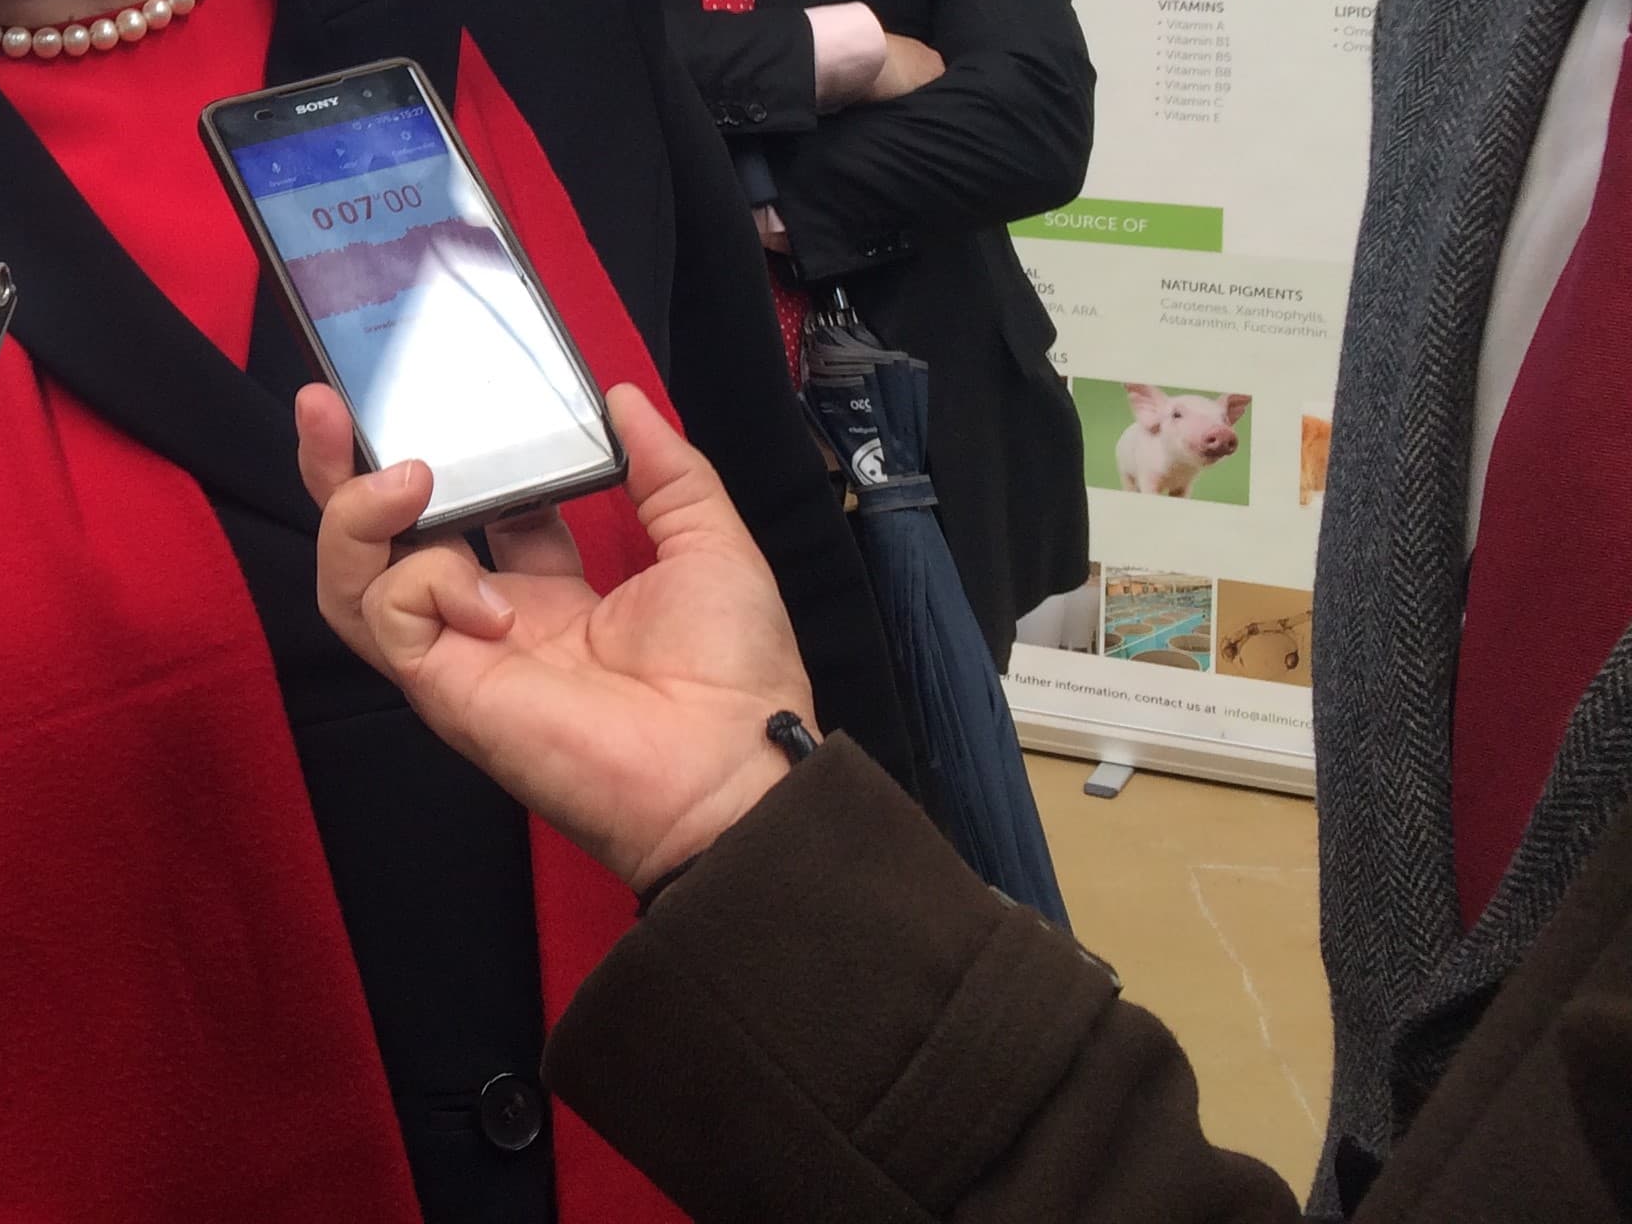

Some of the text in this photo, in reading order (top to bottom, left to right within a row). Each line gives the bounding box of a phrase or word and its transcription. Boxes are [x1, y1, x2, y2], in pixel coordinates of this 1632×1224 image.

[1158, 0, 1225, 14] VITAMINS
[295, 96, 340, 115] SONY
[1044, 212, 1149, 234] SOURCE OF
[1161, 279, 1304, 302] NATURAL PIGMENTS
[1015, 672, 1052, 688] futher
[1055, 679, 1131, 702] information,
[1134, 693, 1183, 709] contact
[1186, 703, 1201, 713] us
[1204, 705, 1217, 715] at
[1224, 706, 1313, 730] info@allmicro
